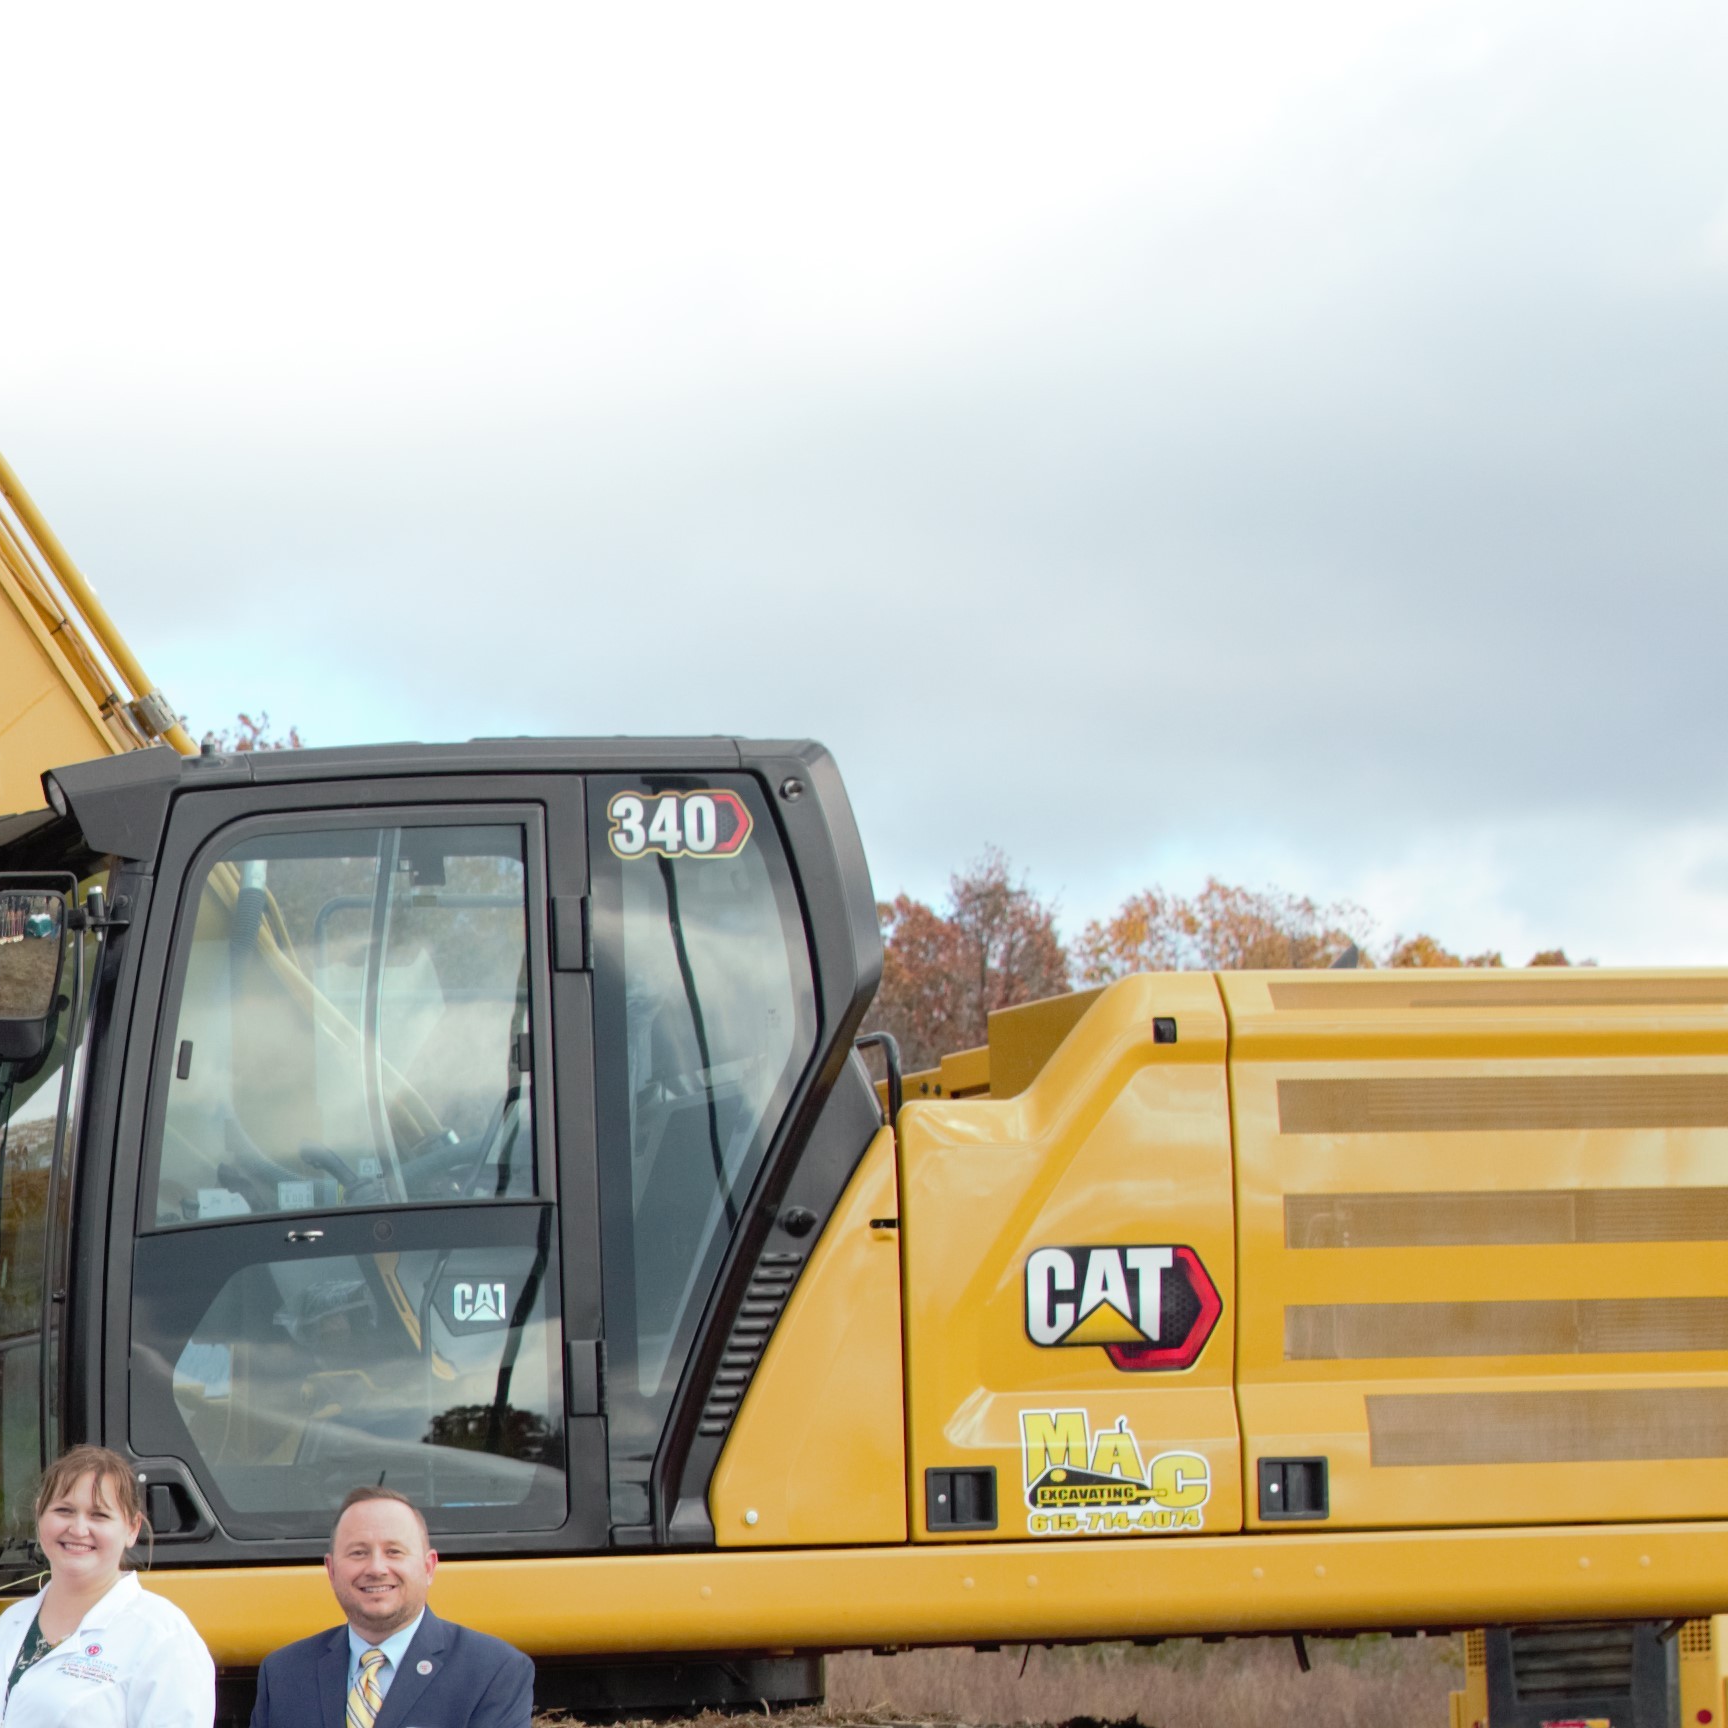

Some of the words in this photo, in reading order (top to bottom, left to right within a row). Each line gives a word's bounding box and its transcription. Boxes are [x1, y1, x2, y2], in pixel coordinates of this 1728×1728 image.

[612, 795, 717, 853] 340
[1027, 1247, 1173, 1344] CAT
[1039, 1487, 1134, 1502] EXCAVATING
[1029, 1509, 1202, 1533] 615-714-4074
